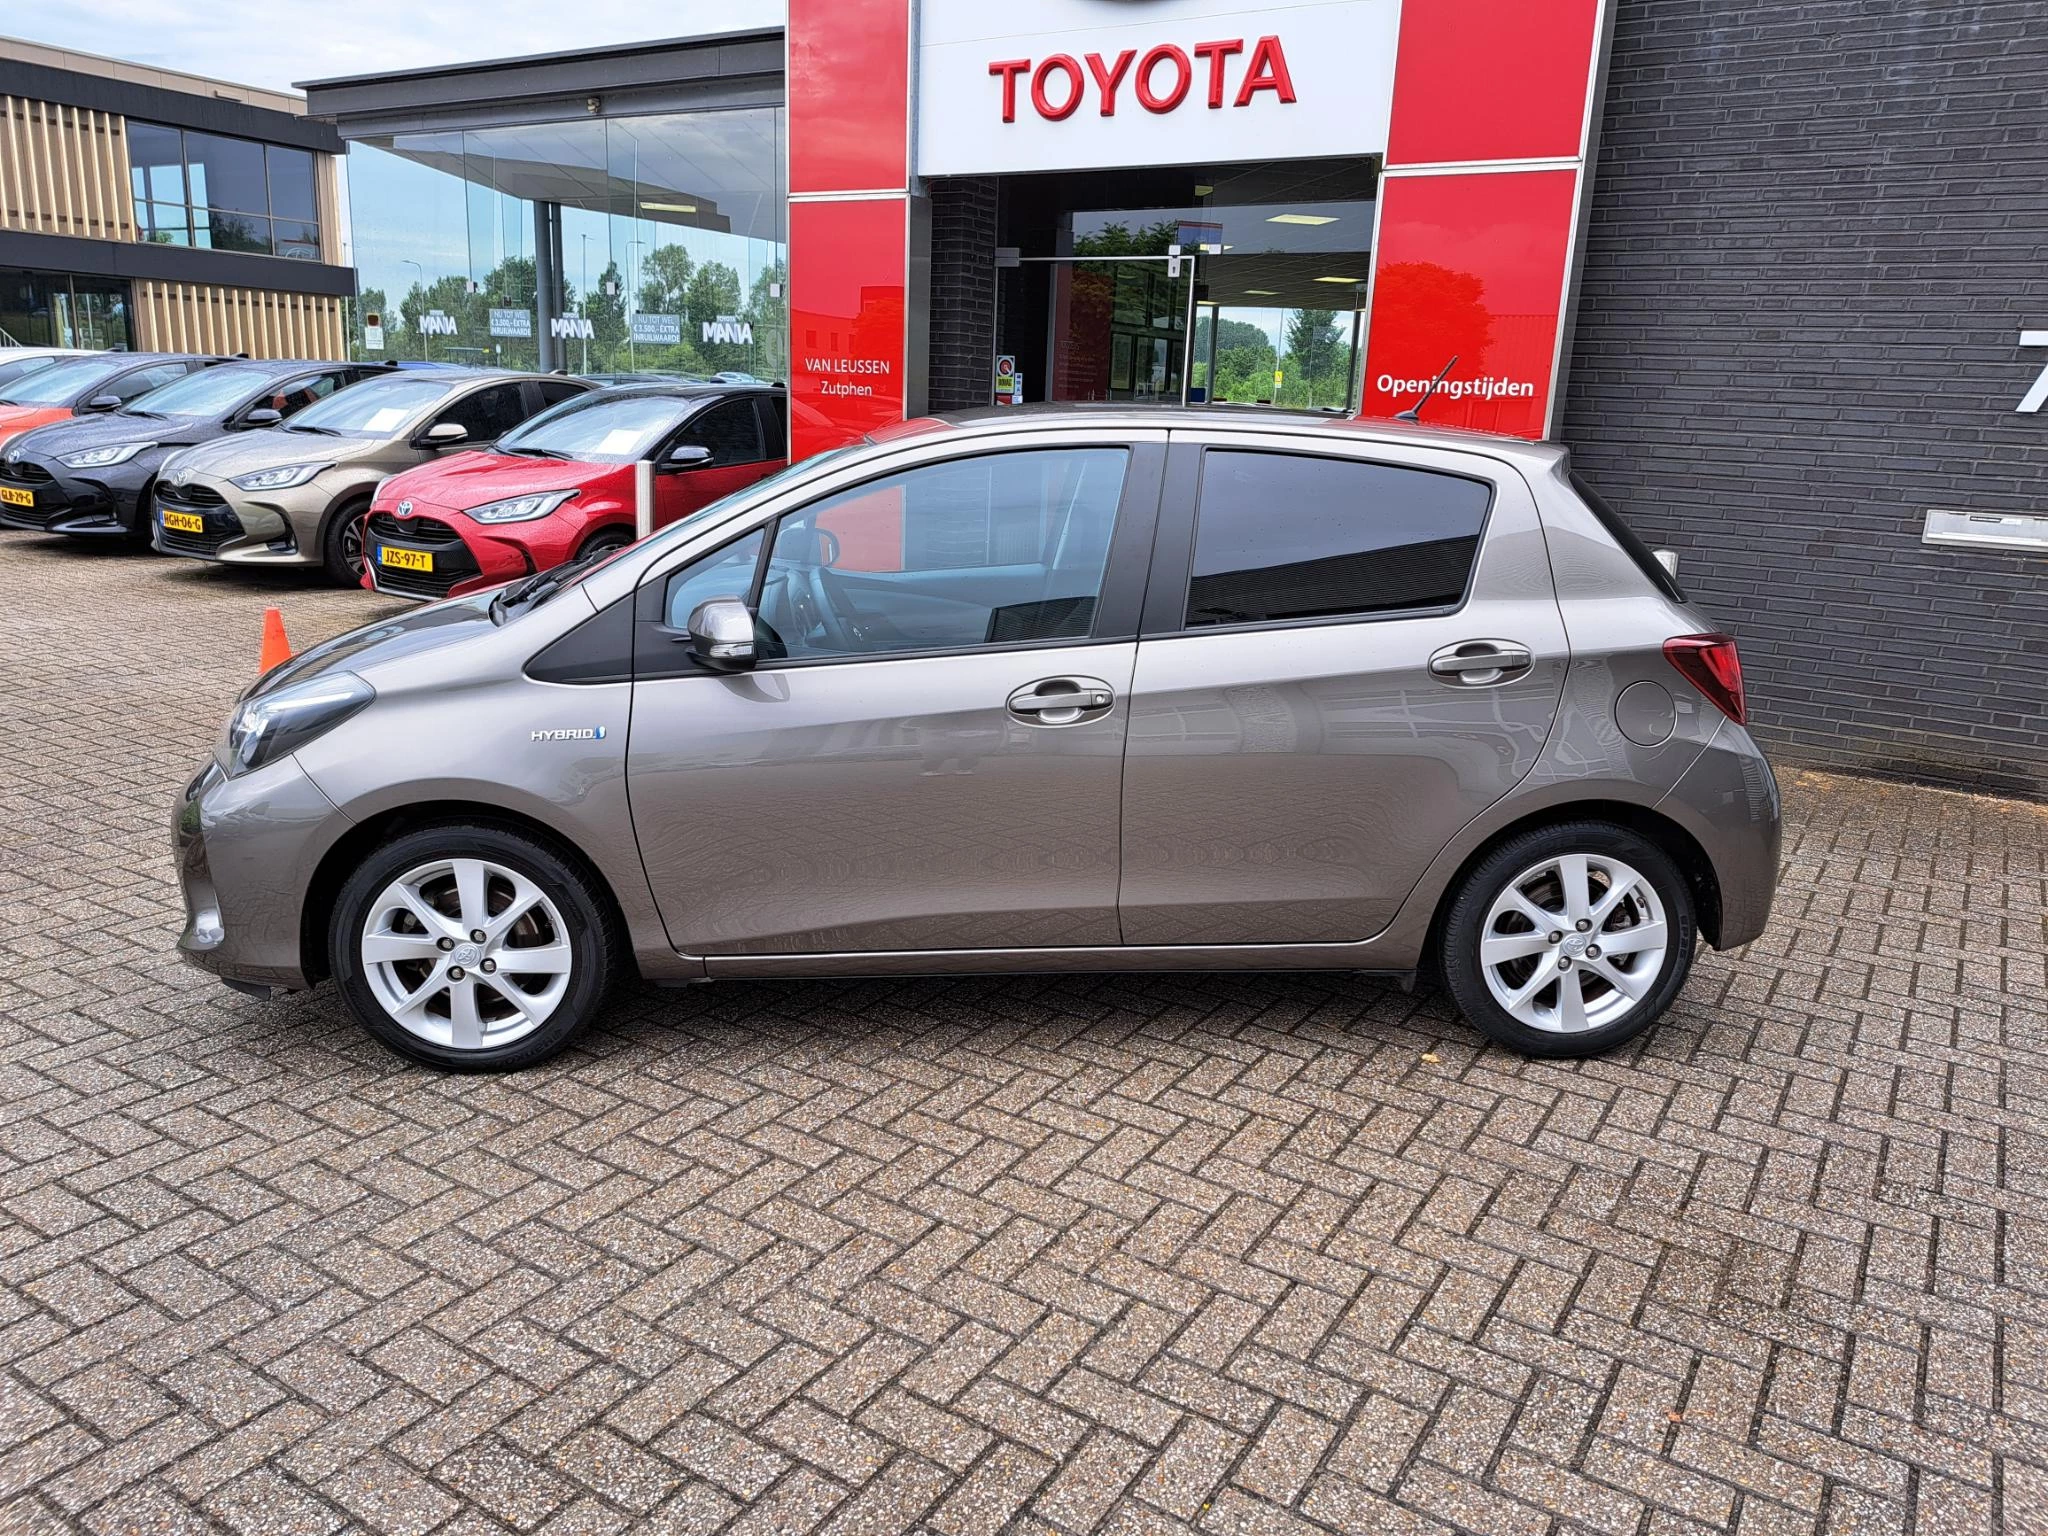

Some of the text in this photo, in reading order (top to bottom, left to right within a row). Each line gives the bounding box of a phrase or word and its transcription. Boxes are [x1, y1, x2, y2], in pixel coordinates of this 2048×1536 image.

[989, 34, 1298, 124] TOYOTA
[419, 315, 458, 335] MANIA
[551, 318, 595, 339] MANIA
[660, 325, 680, 334] EXTRA
[702, 321, 754, 344] MANIA
[805, 358, 890, 374] VAN LEUSSEN
[821, 381, 872, 398] Zutphen
[1377, 374, 1534, 400] Openingstijden
[164, 512, 201, 531] HGH-06-G
[385, 549, 426, 569] JZS-97-T
[531, 728, 594, 741] HYBRID
